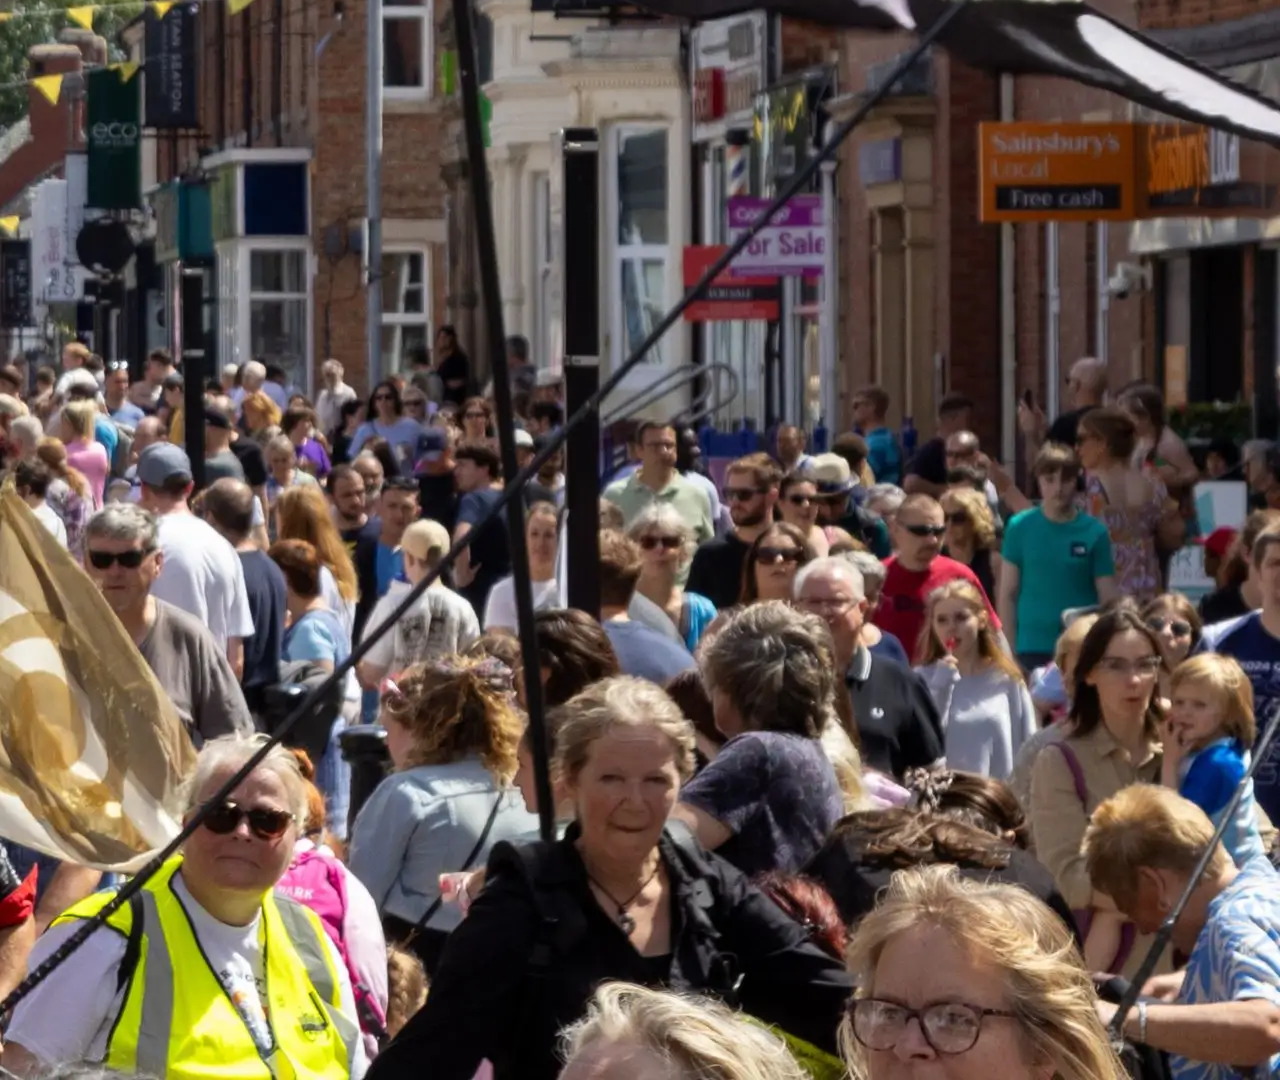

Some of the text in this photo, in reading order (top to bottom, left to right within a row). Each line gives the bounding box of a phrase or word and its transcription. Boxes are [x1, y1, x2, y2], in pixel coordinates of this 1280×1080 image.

[92, 121, 138, 139] eco
[993, 131, 1121, 155] Sainsbury's
[994, 158, 1049, 178] Local
[1011, 187, 1104, 207] Free cash
